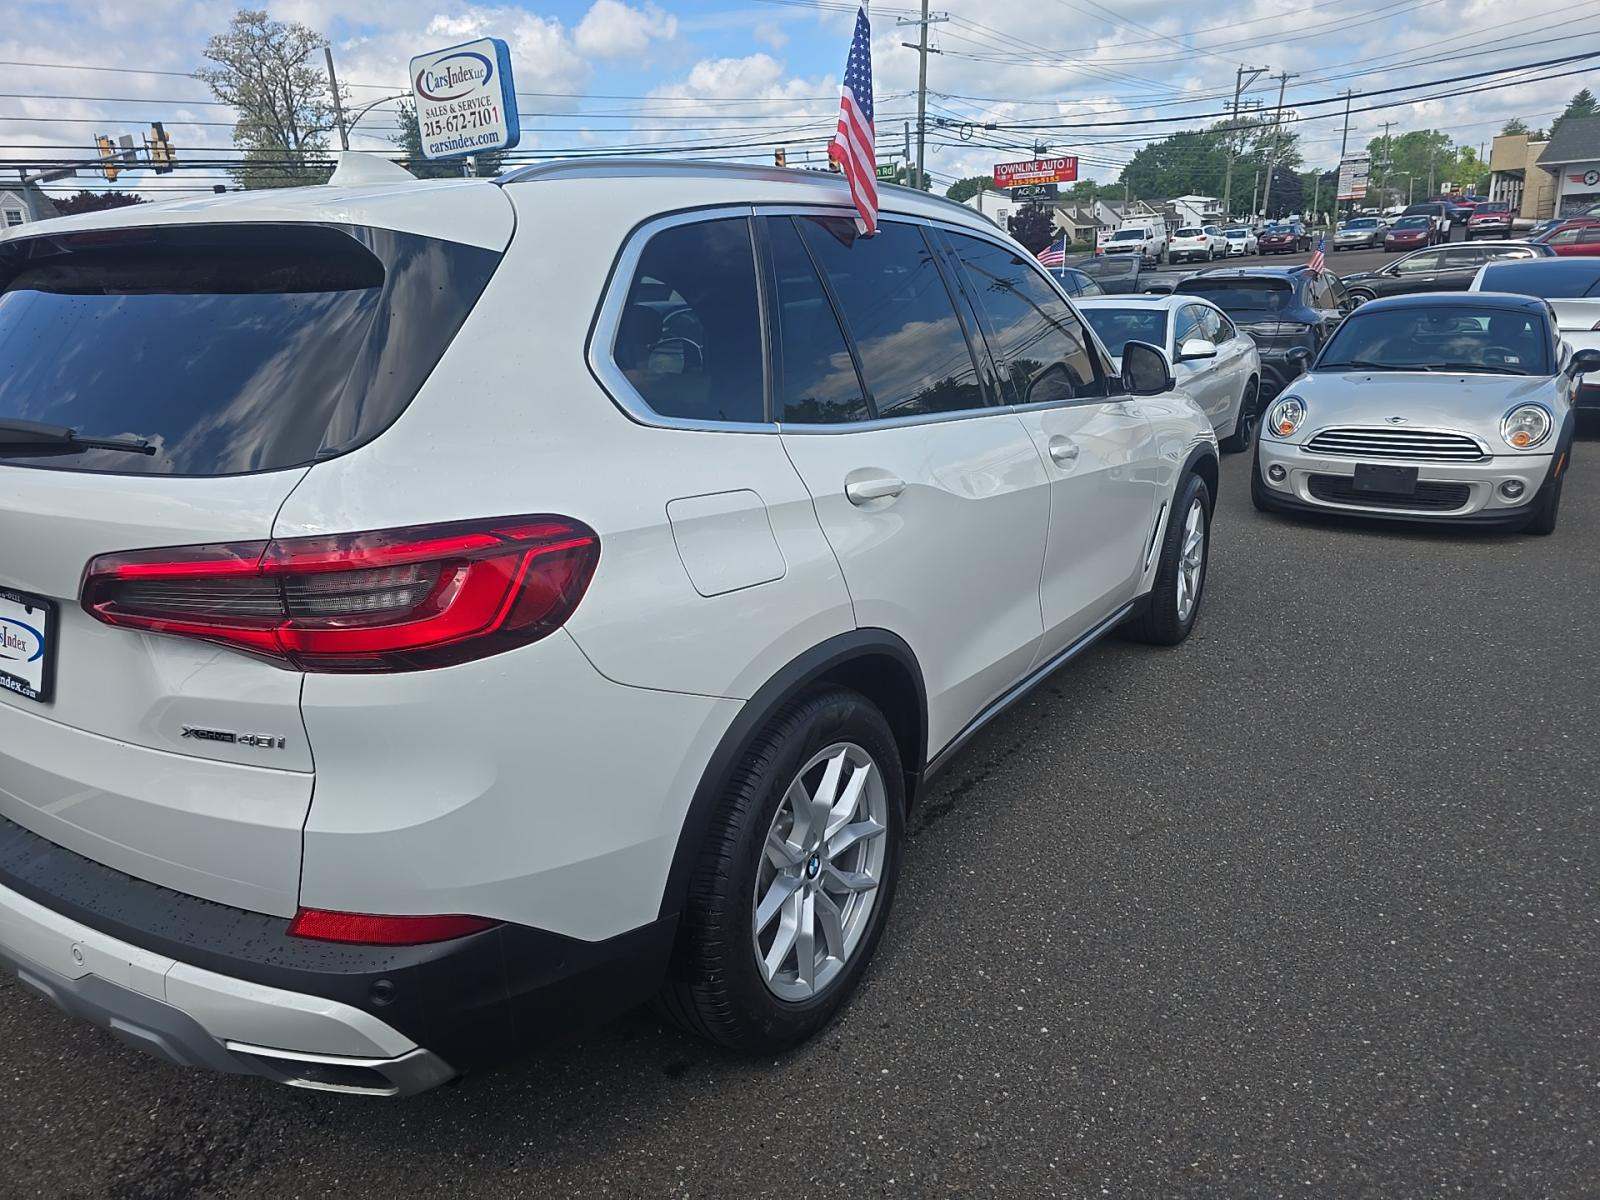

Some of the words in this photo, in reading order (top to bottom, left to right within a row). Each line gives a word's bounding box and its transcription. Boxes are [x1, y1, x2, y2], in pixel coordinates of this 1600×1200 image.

[426, 66, 474, 93] CarsIndex
[425, 103, 448, 119] SALES
[449, 103, 457, 115] &
[457, 95, 492, 112] SERVICE
[423, 106, 499, 138] 215-672-7101
[429, 131, 500, 154] carsindex.com
[882, 167, 893, 176] Rd
[996, 161, 1040, 175] TOWNLINE
[1042, 159, 1065, 171] AUTO
[1017, 186, 1047, 196] AGORA
[0, 676, 36, 699] ndex.com
